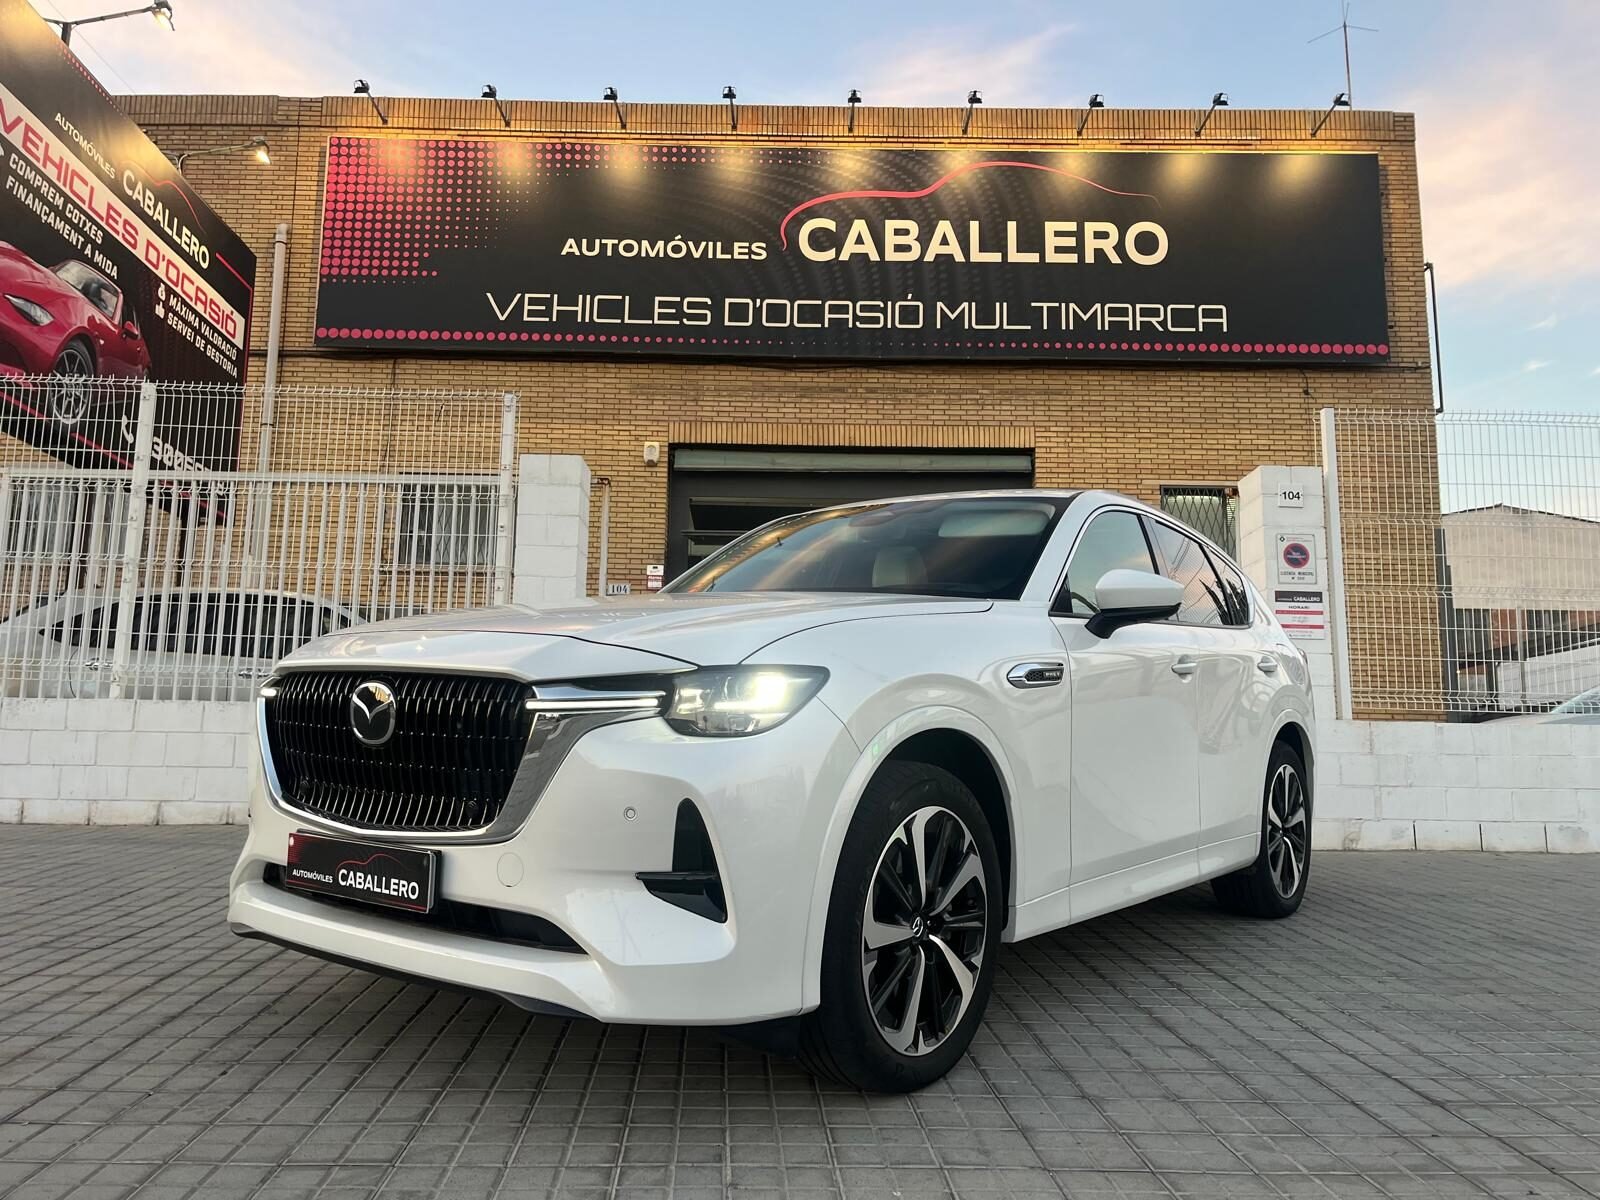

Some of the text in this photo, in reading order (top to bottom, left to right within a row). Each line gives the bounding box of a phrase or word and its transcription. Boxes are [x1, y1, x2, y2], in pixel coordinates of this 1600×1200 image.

[0, 97, 237, 340] VEHICLES D'OCASIÓ
[9, 152, 104, 245] COMPREM COTXES
[54, 112, 210, 269] AUTOMÓVILES CABALLERO
[5, 175, 118, 280] FINANÇAMENT A MIDA
[561, 217, 1169, 266] AUTOMÓVILES CABALLERO
[167, 312, 238, 378] SERVEI DE GESTORIA
[169, 294, 237, 361] MÀXIMA VALORACIÓ
[486, 292, 1228, 333] VEHICLES D'OCASIÓ MULTIMARCA
[1282, 491, 1301, 500] 104
[612, 584, 628, 593] 104
[292, 868, 419, 900] AUTOMÓVILES CABALLERO
